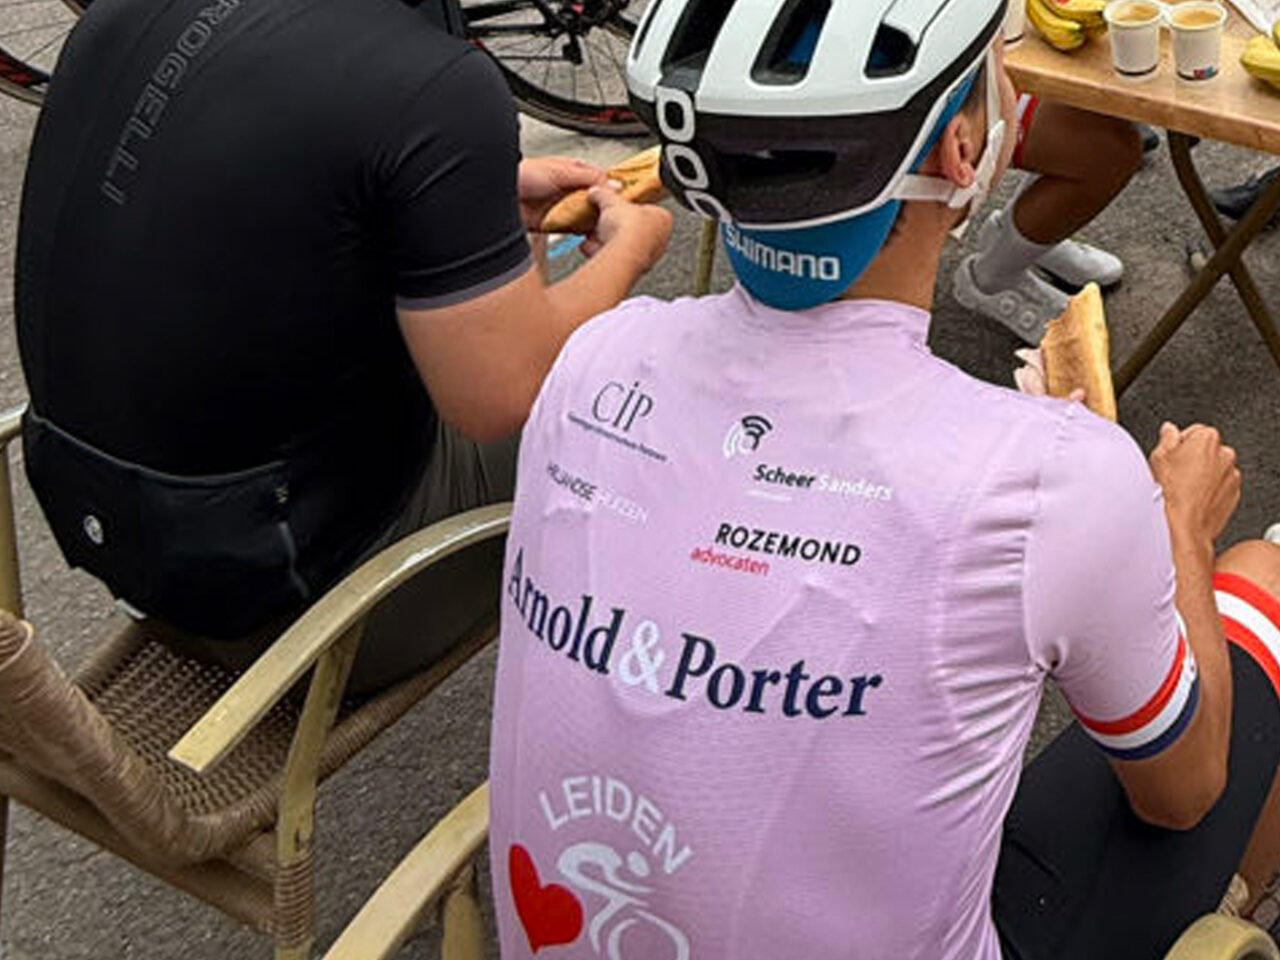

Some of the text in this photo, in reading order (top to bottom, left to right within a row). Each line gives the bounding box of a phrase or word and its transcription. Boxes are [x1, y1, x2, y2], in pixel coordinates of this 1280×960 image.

[725, 223, 840, 281] SHIMANO
[754, 463, 816, 488] Scheer
[818, 473, 894, 502] Sanders
[690, 546, 770, 577] advocaten
[714, 522, 862, 566] ROZEMOND
[539, 775, 694, 875] LEIDEN
